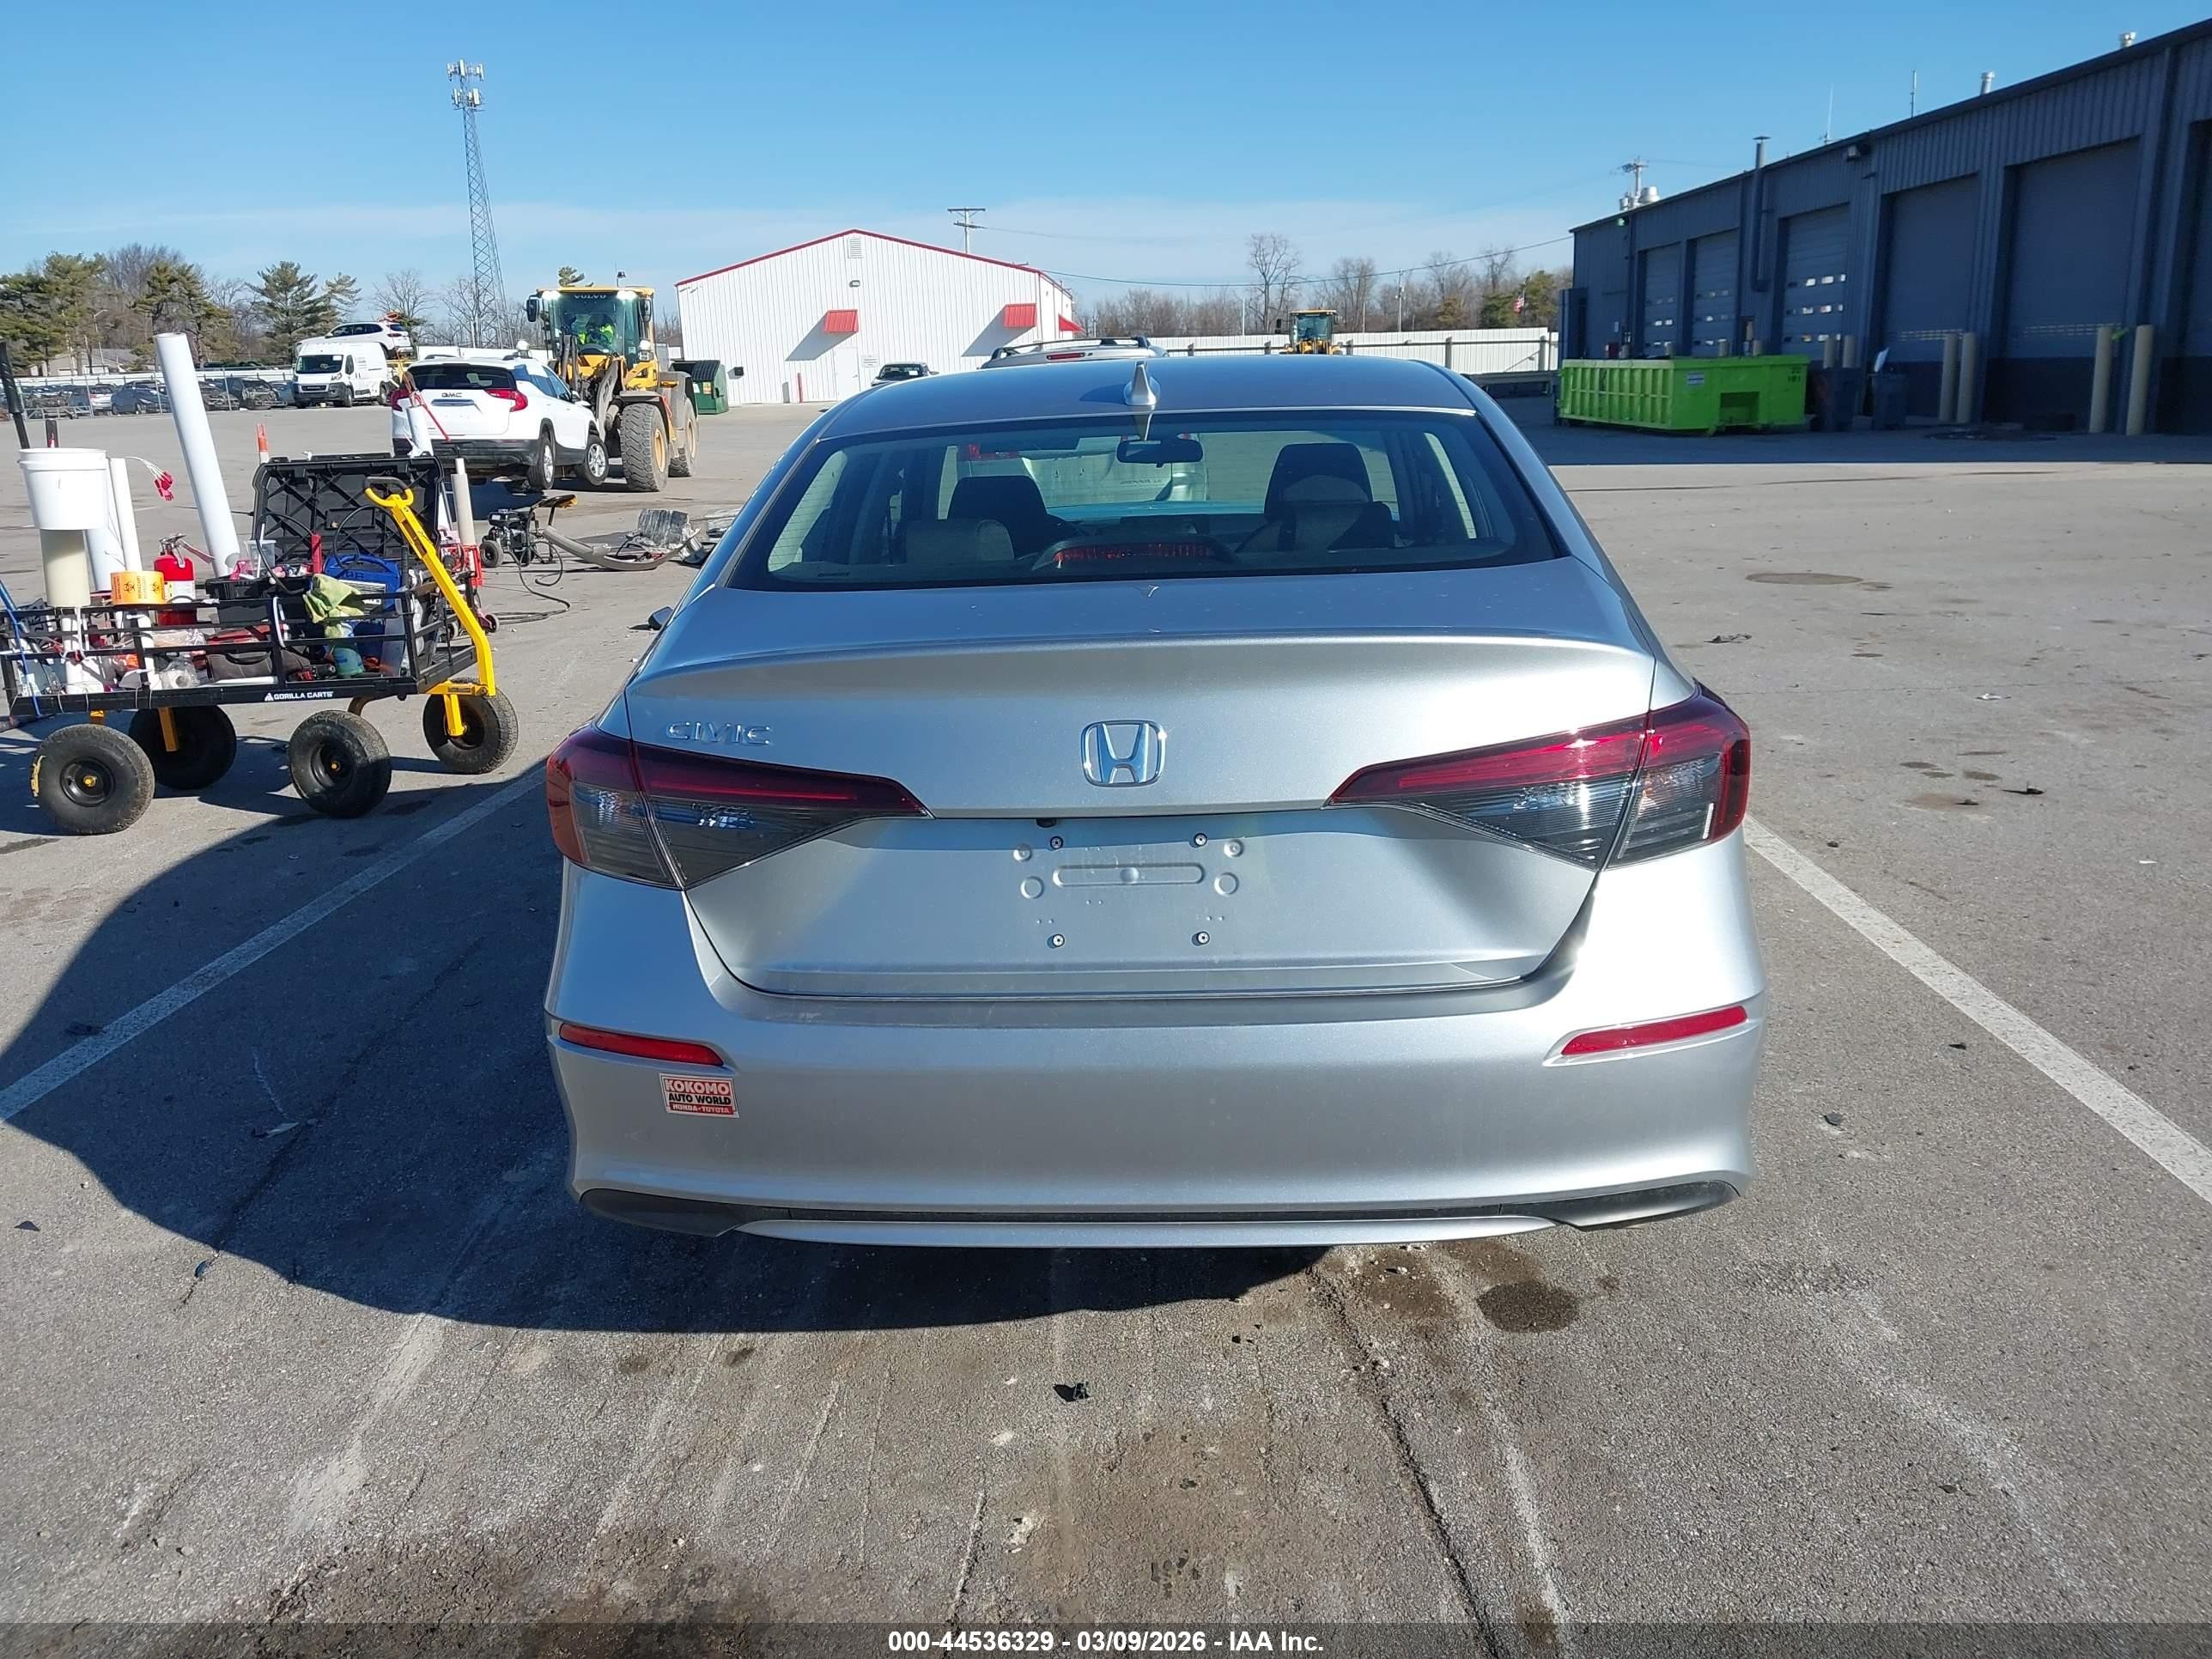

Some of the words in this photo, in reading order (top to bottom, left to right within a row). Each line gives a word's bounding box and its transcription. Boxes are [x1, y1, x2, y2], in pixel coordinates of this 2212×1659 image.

[666, 721, 771, 745] CIVIC
[664, 1079, 730, 1095] KOKOMO
[669, 1092, 693, 1103] AUTO
[695, 1094, 732, 1105] WORLD
